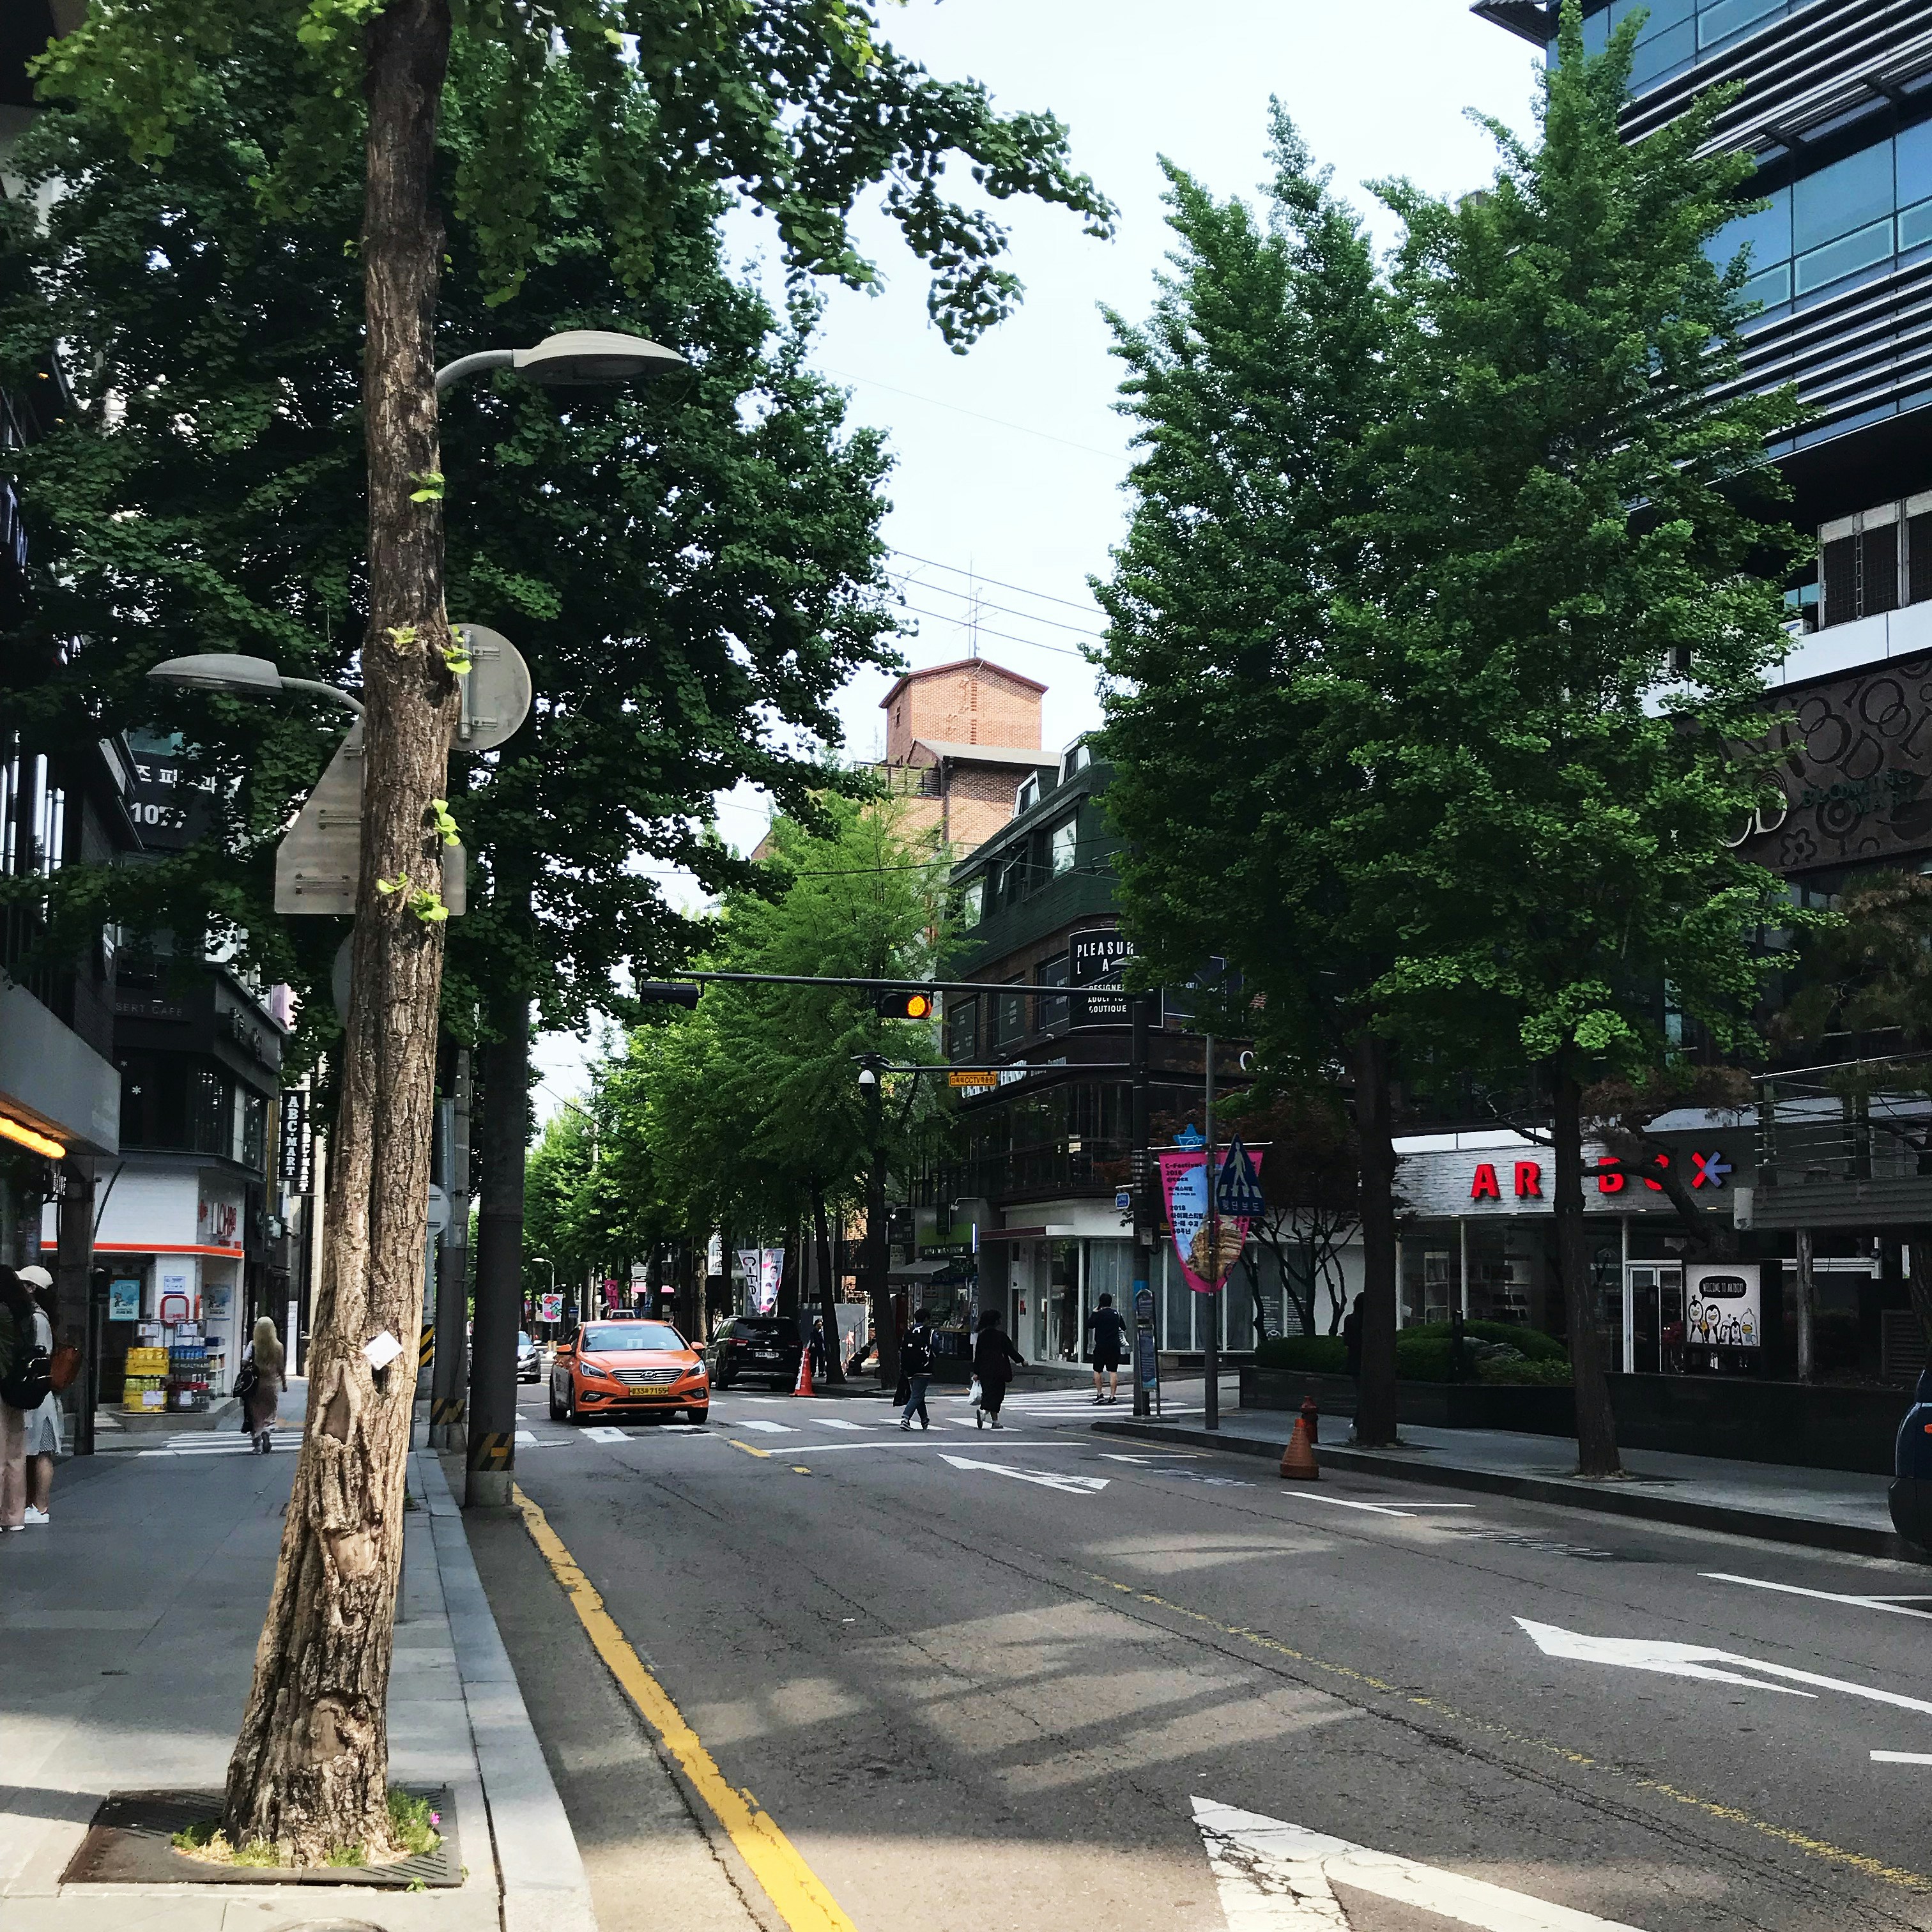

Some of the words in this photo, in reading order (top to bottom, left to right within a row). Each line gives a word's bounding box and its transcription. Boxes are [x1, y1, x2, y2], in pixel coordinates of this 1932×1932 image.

[1077, 941, 1134, 958] PLEASUR
[116, 1002, 146, 1013] SERT
[1470, 1150, 1732, 1199] ARBX
[1222, 1199, 1261, 1211] 횡단보도
